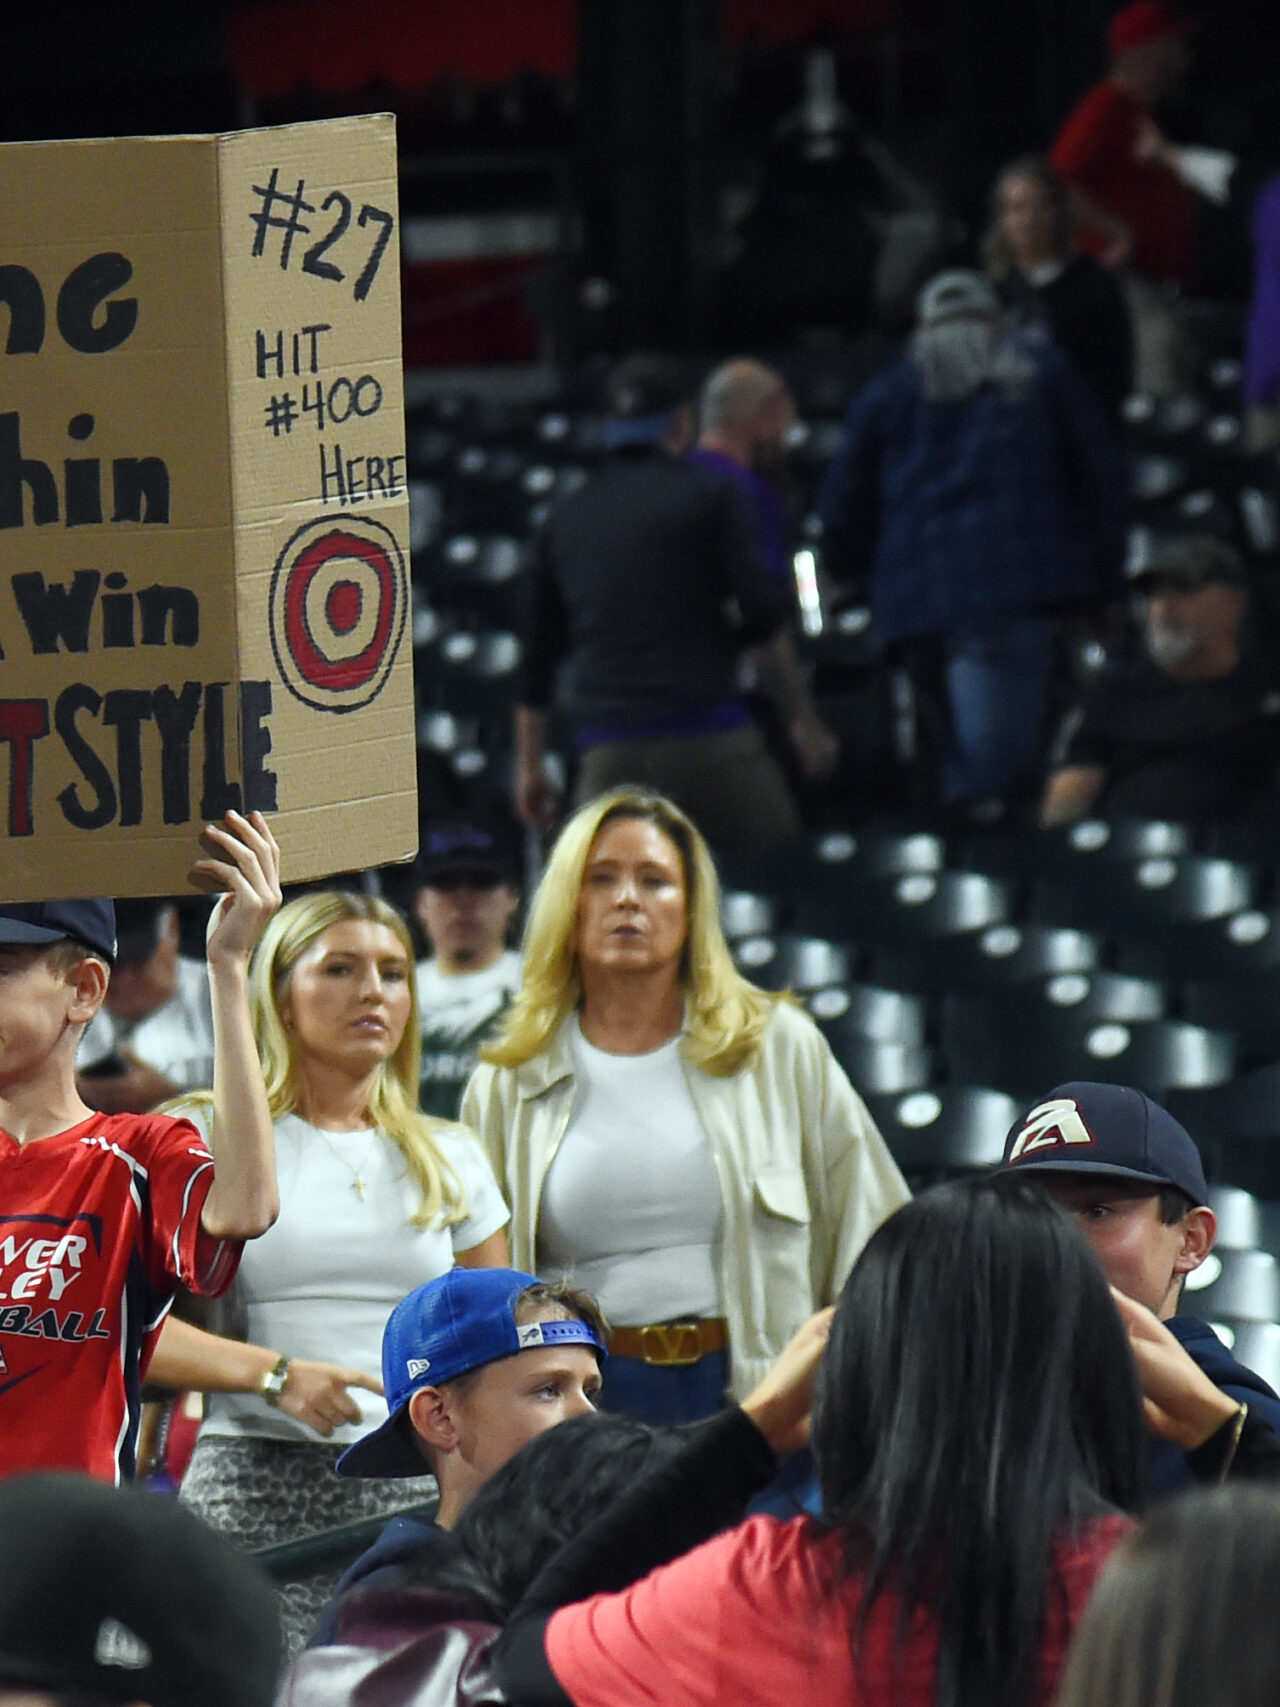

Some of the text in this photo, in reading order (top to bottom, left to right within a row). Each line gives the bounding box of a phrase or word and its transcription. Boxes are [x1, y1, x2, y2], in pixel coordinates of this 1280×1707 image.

[250, 168, 394, 302] #27
[256, 323, 332, 379] HIT
[264, 374, 383, 437] #400
[319, 443, 406, 507] HERE
[11, 569, 200, 655] Win
[54, 680, 279, 830] STYLE
